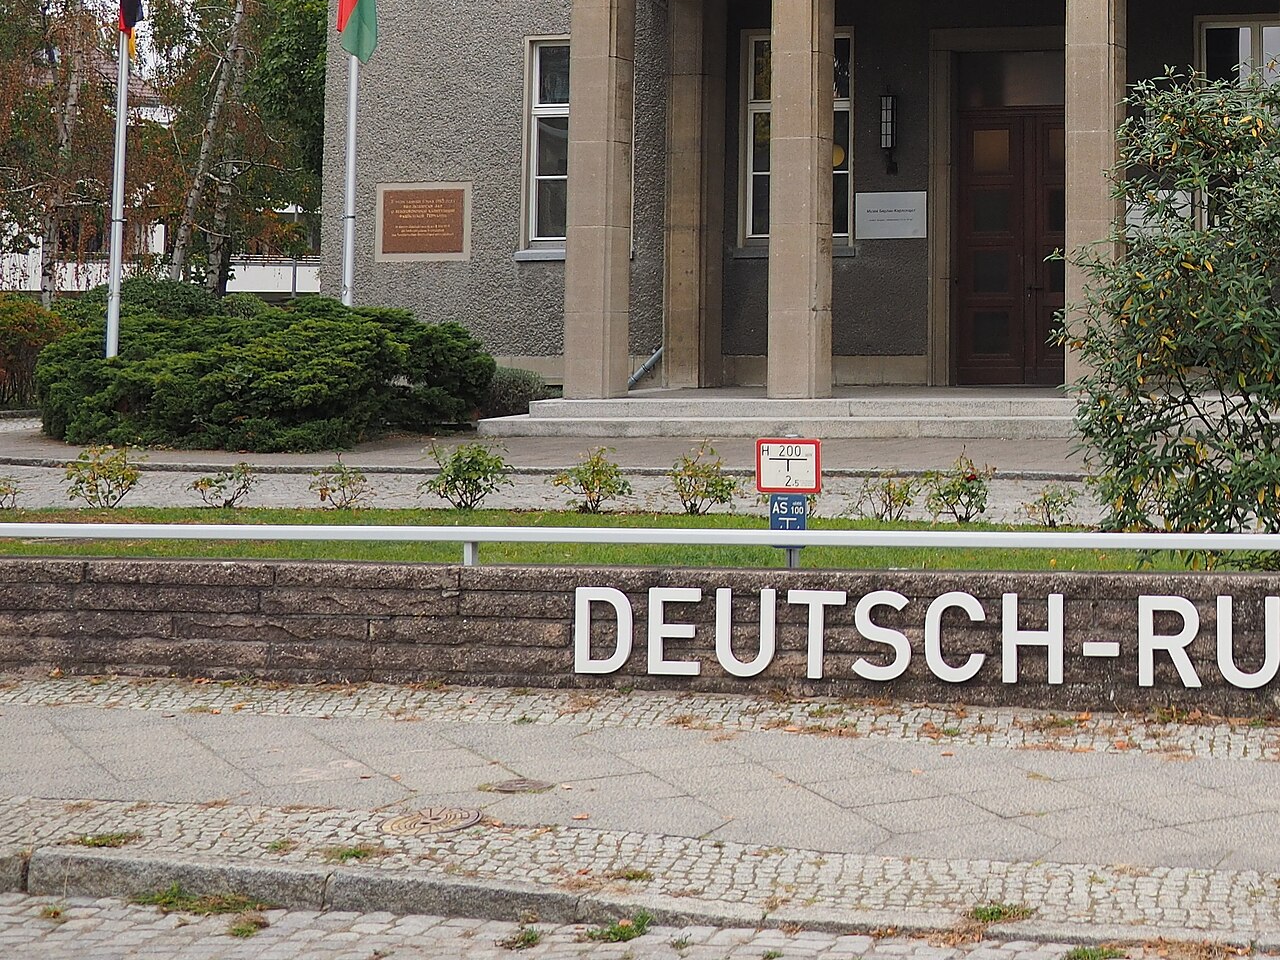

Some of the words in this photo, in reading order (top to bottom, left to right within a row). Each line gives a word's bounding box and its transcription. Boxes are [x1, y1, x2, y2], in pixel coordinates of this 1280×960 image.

[762, 445, 769, 456] H
[779, 445, 802, 457] 200
[772, 501, 788, 514] AS
